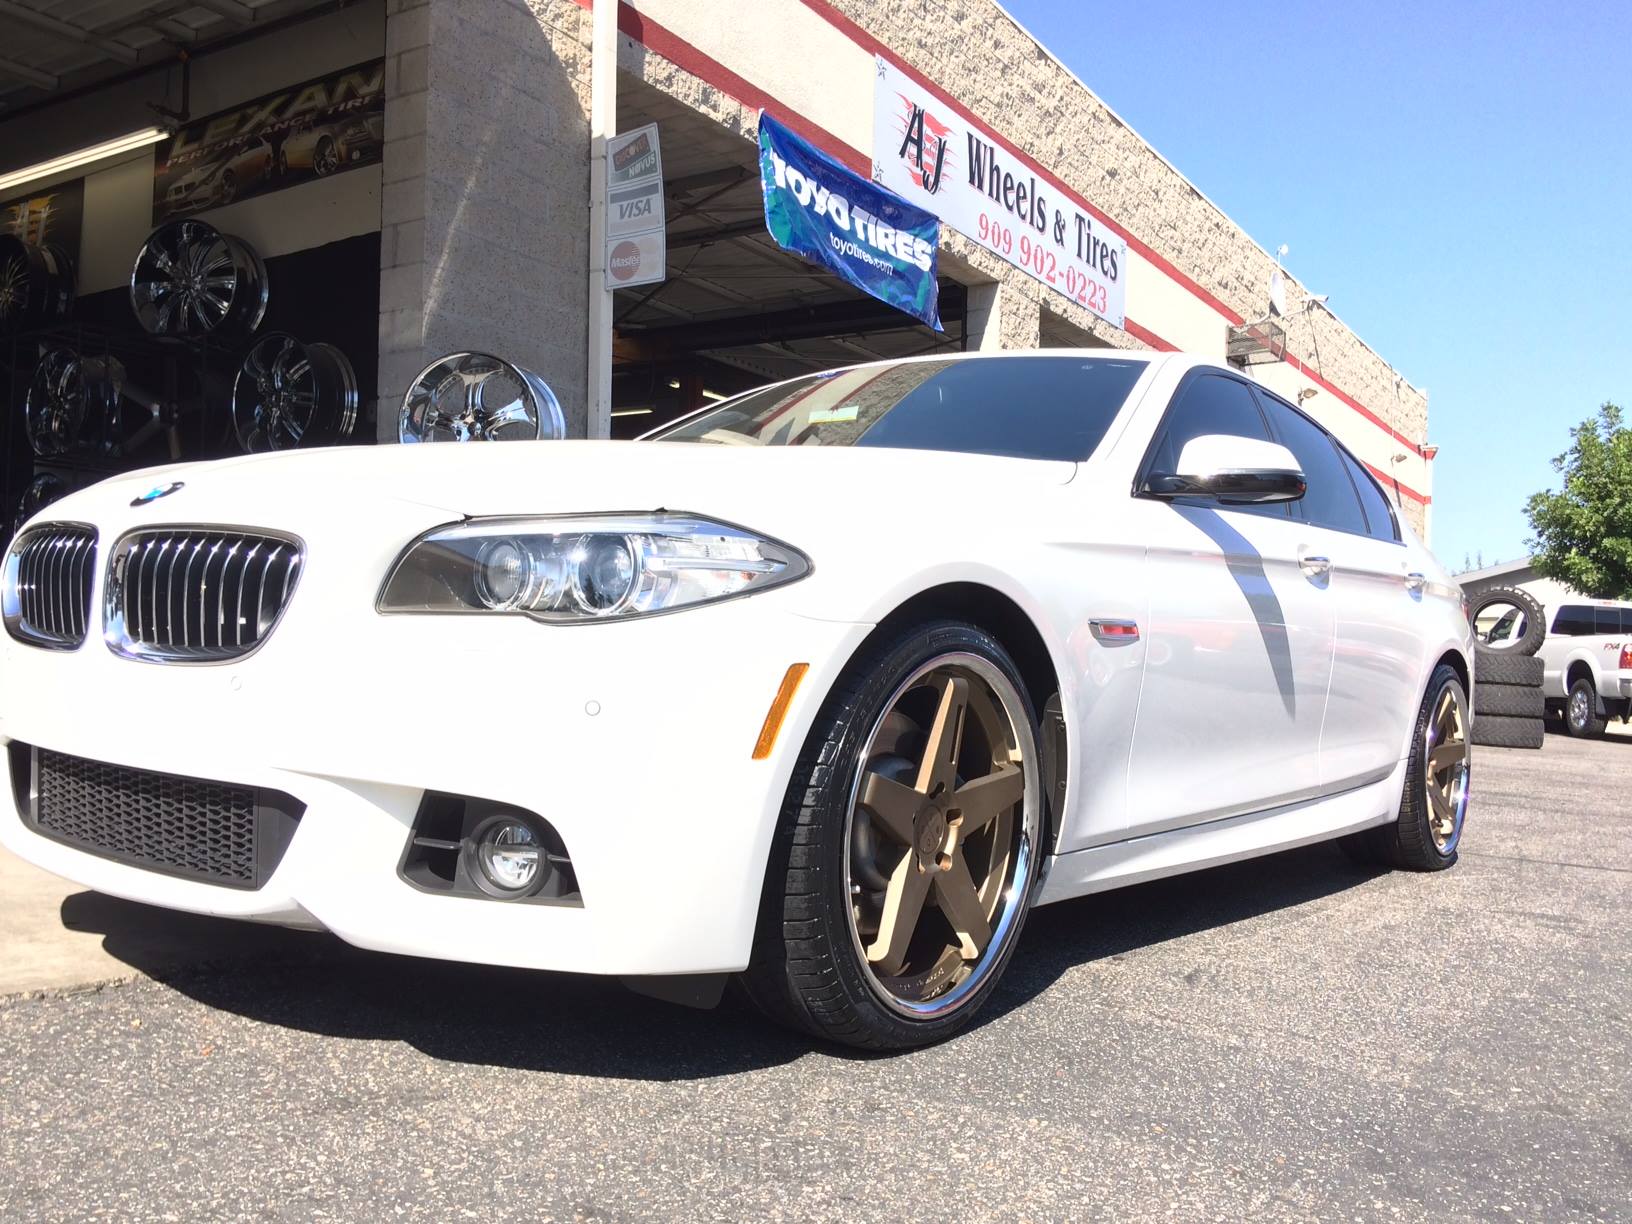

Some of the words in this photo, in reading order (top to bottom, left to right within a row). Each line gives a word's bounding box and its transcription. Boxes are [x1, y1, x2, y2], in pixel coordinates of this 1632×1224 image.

[618, 198, 652, 220] VISA
[769, 148, 851, 232] TOYO
[850, 205, 933, 273] TIRES
[829, 231, 894, 277] toyotires.com
[966, 130, 1048, 235] Wheels
[1053, 208, 1067, 248] &
[1074, 211, 1119, 283] Tires
[978, 212, 1013, 256] 909
[1018, 235, 1108, 315] 902-0223
